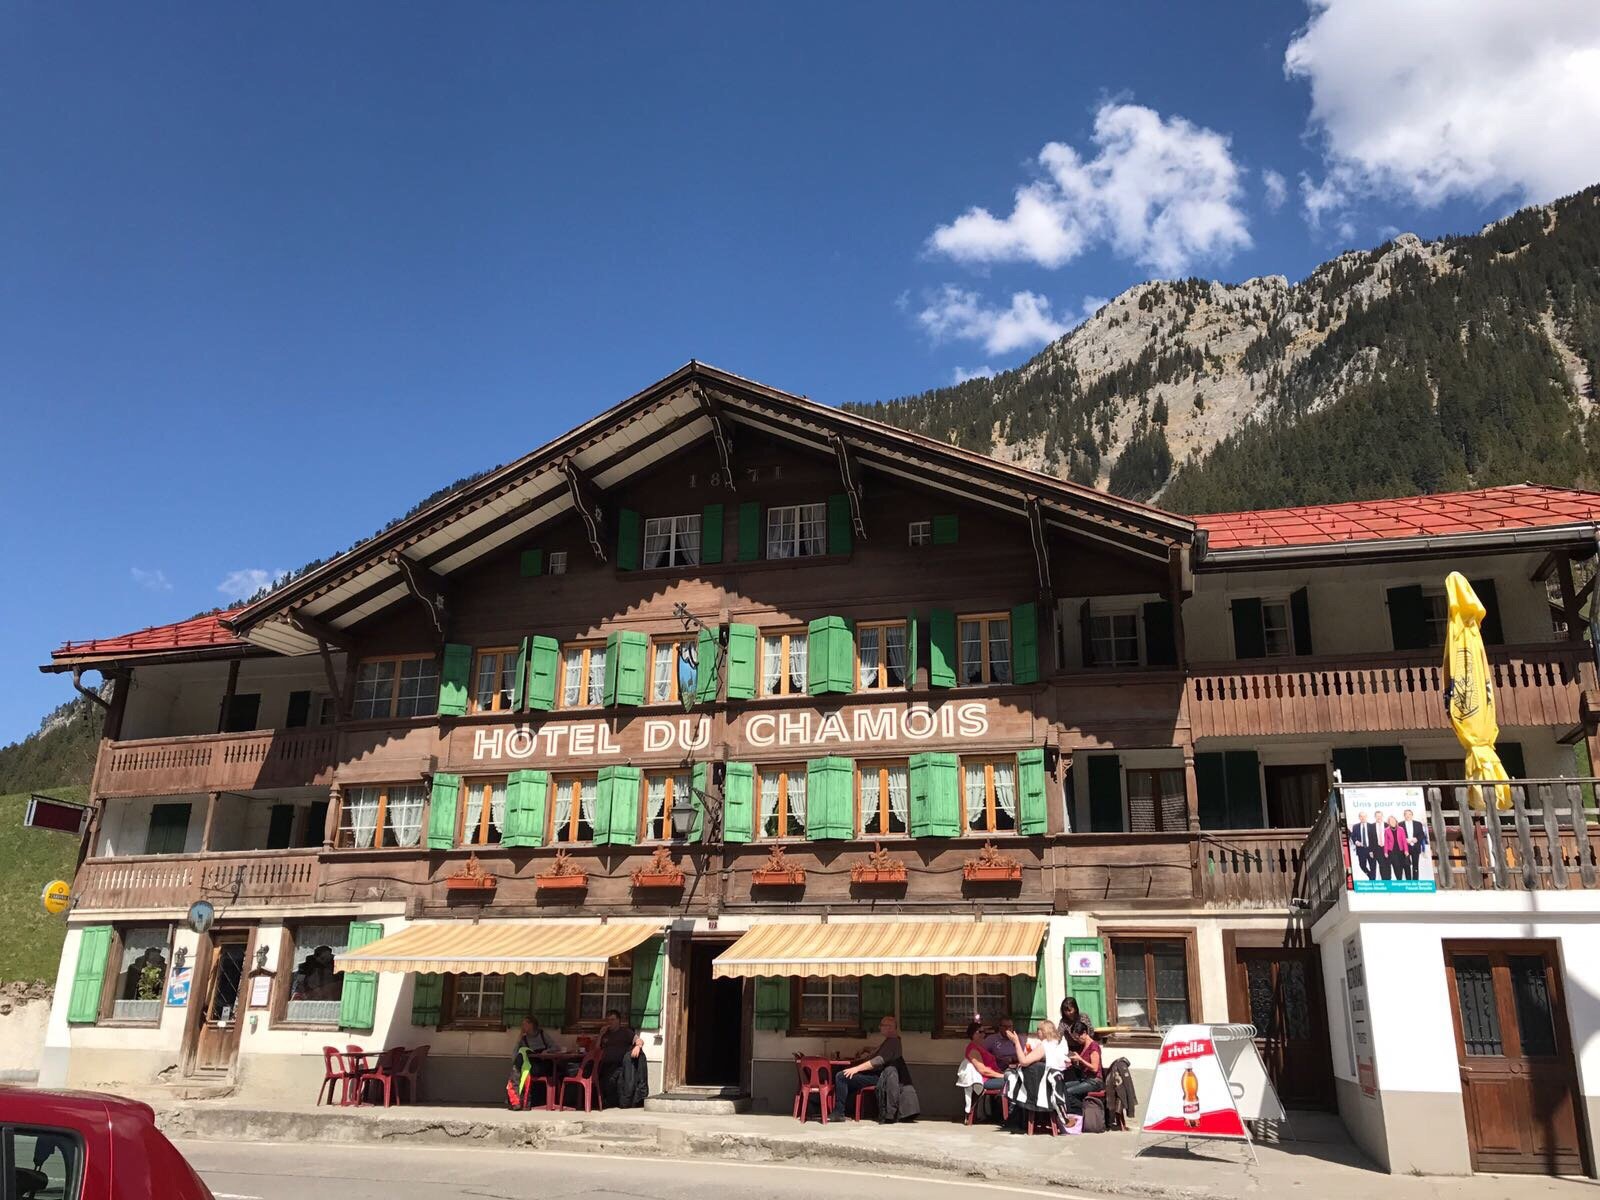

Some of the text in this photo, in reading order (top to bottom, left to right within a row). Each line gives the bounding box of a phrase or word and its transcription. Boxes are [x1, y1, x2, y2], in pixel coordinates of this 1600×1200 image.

[689, 466, 783, 488] 1871
[472, 702, 990, 760] HOTEL DU CHAMOIS
[1352, 800, 1371, 808] Unis
[1167, 1041, 1205, 1058] rivella
